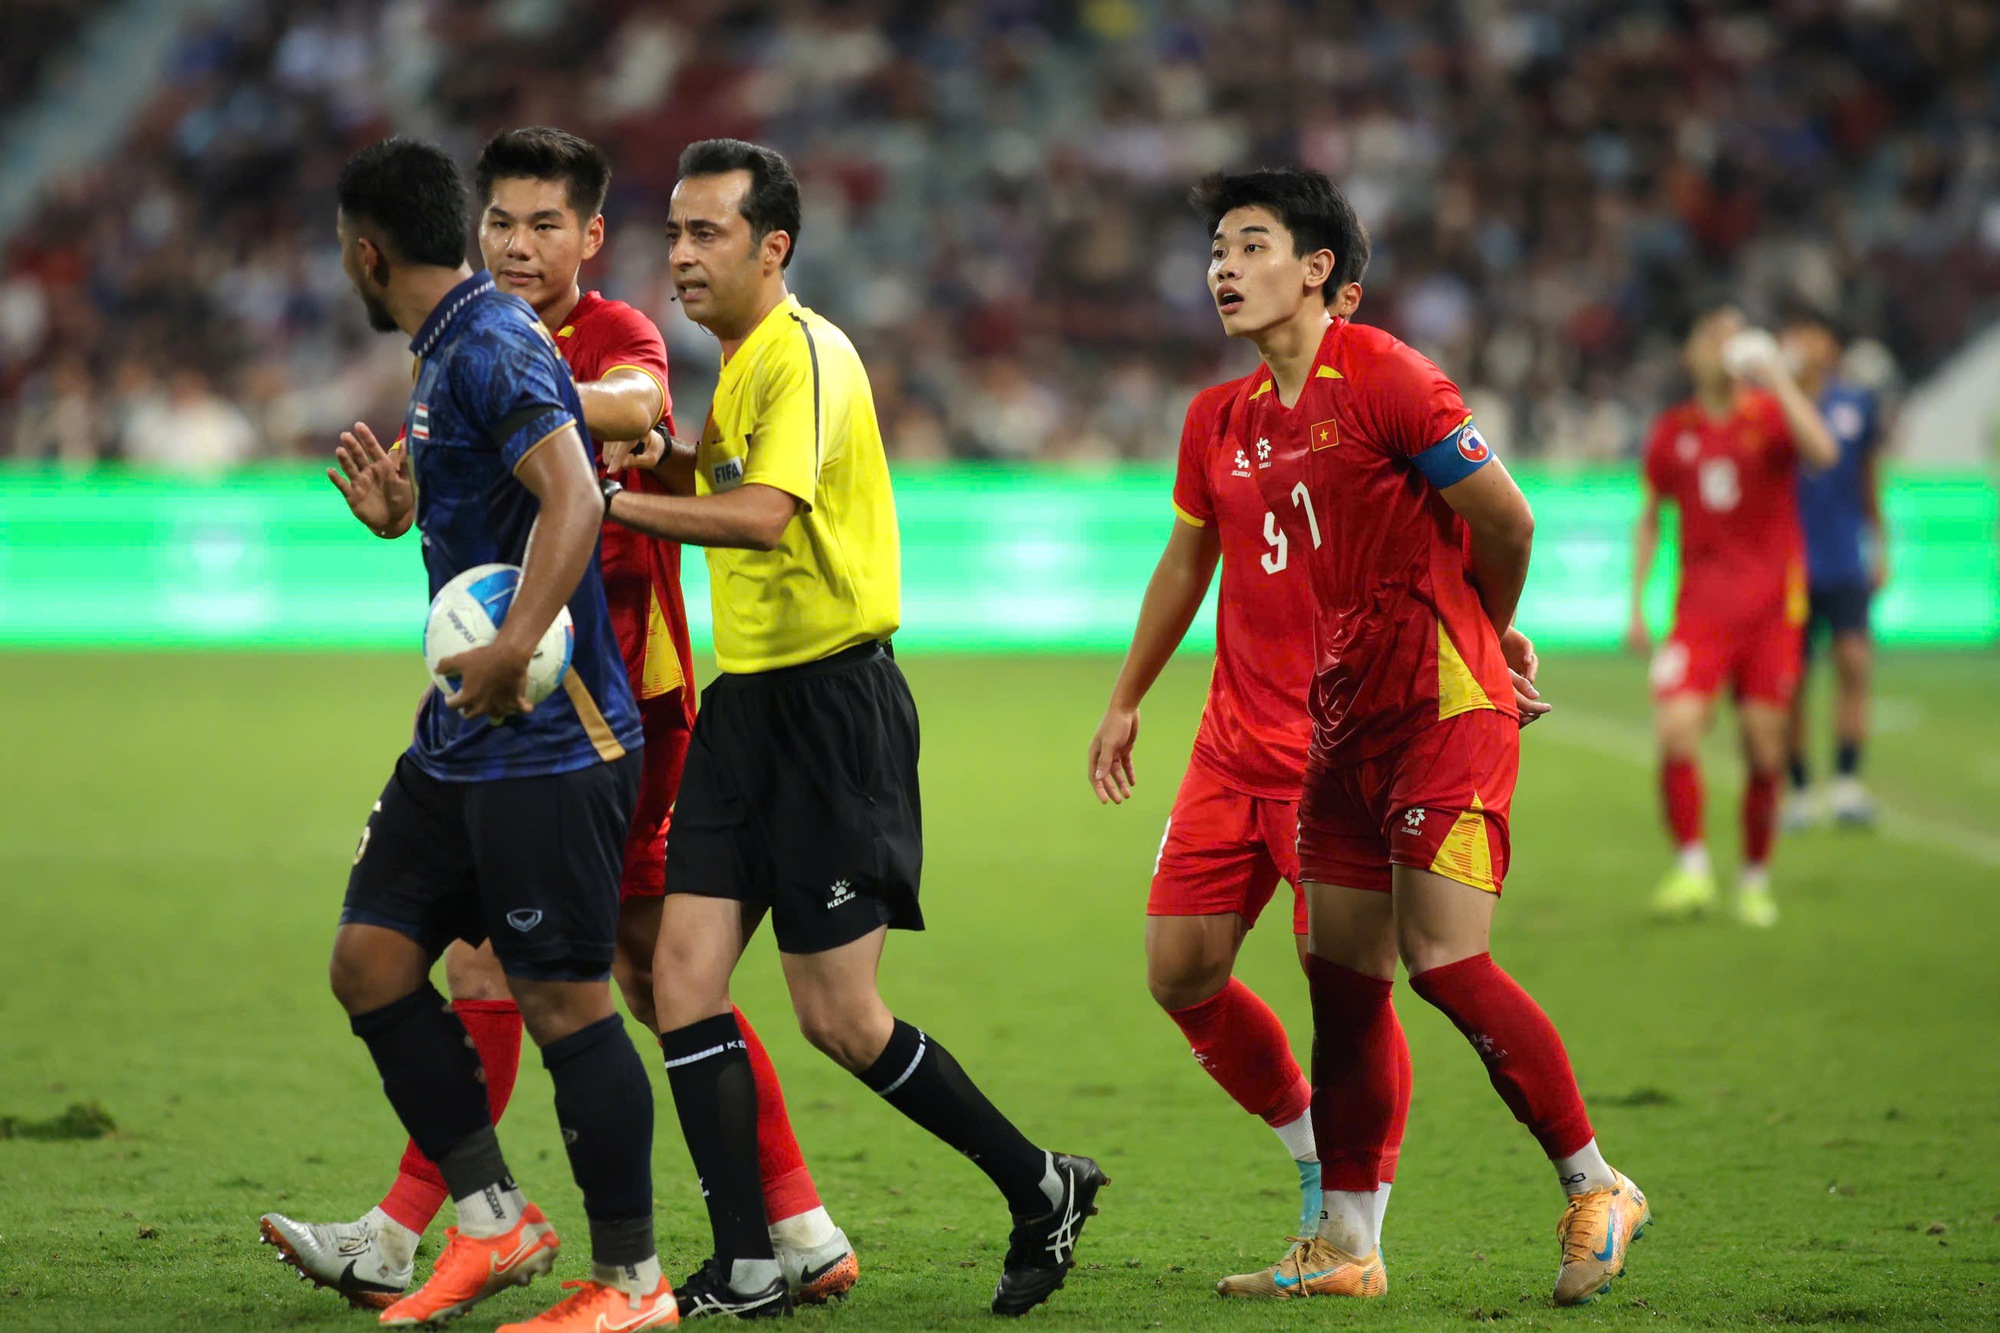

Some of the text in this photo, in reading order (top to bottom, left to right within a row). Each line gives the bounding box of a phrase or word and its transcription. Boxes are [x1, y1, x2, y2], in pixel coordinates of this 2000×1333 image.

[714, 463, 741, 484] FIFA
[1291, 480, 1322, 551] 7
[1260, 511, 1288, 575] 9
[827, 891, 856, 910] KELME
